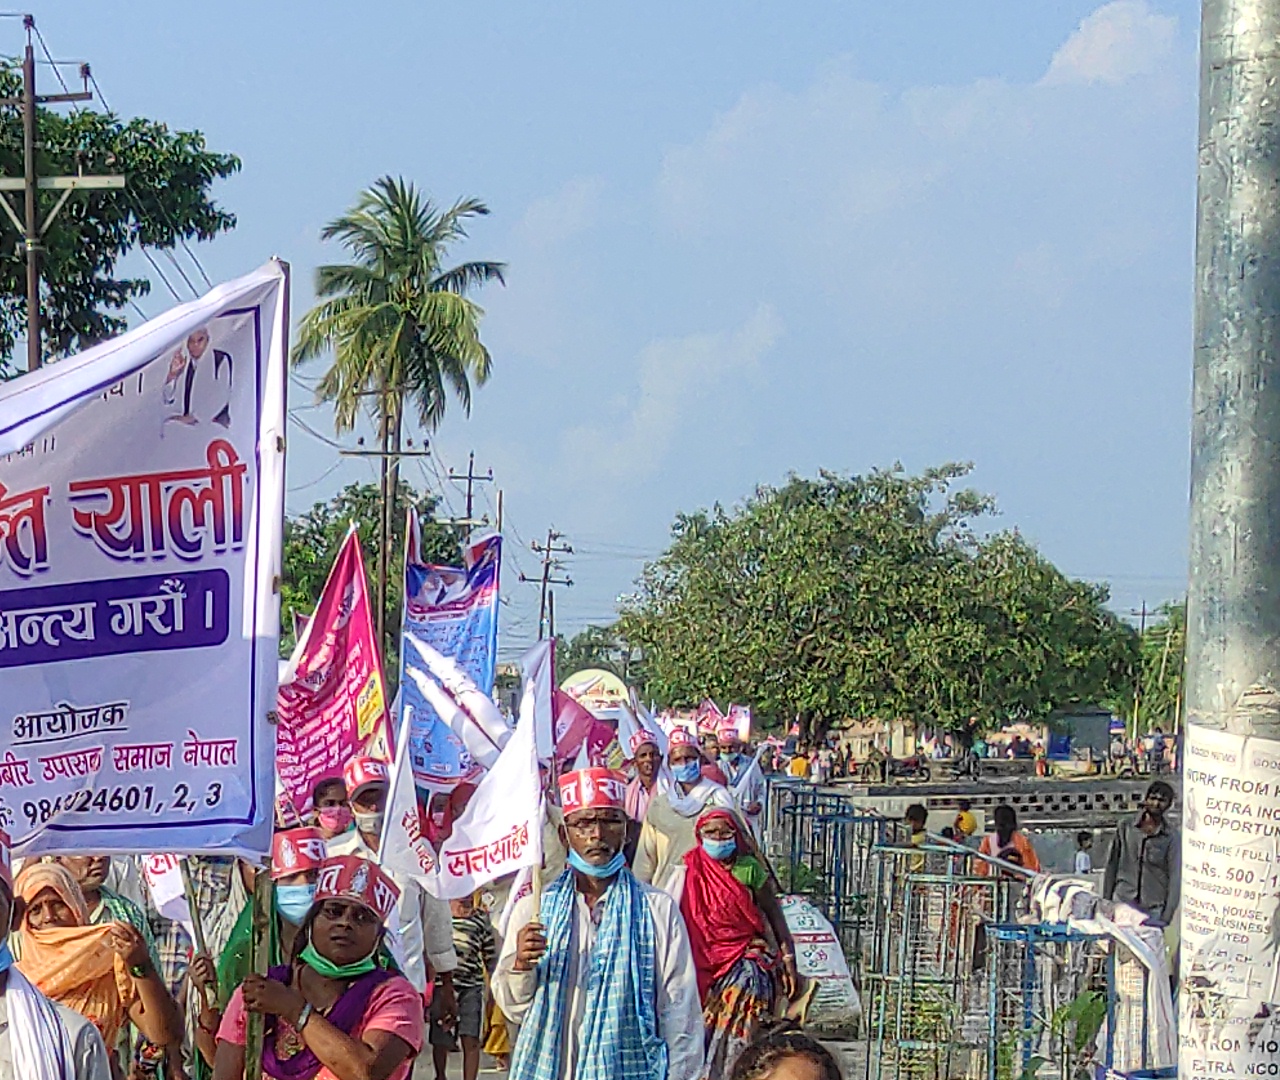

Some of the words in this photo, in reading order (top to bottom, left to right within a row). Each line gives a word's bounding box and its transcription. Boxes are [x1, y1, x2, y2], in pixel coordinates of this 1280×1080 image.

[13, 702, 130, 740] आयोजक
[40, 747, 103, 782] उपासक
[113, 742, 174, 773] समाज
[183, 730, 238, 768] नेपाल
[1219, 776, 1269, 796] FROM
[1206, 797, 1253, 817] EXTRA
[1241, 849, 1271, 863] FULL
[1226, 867, 1254, 885] 500
